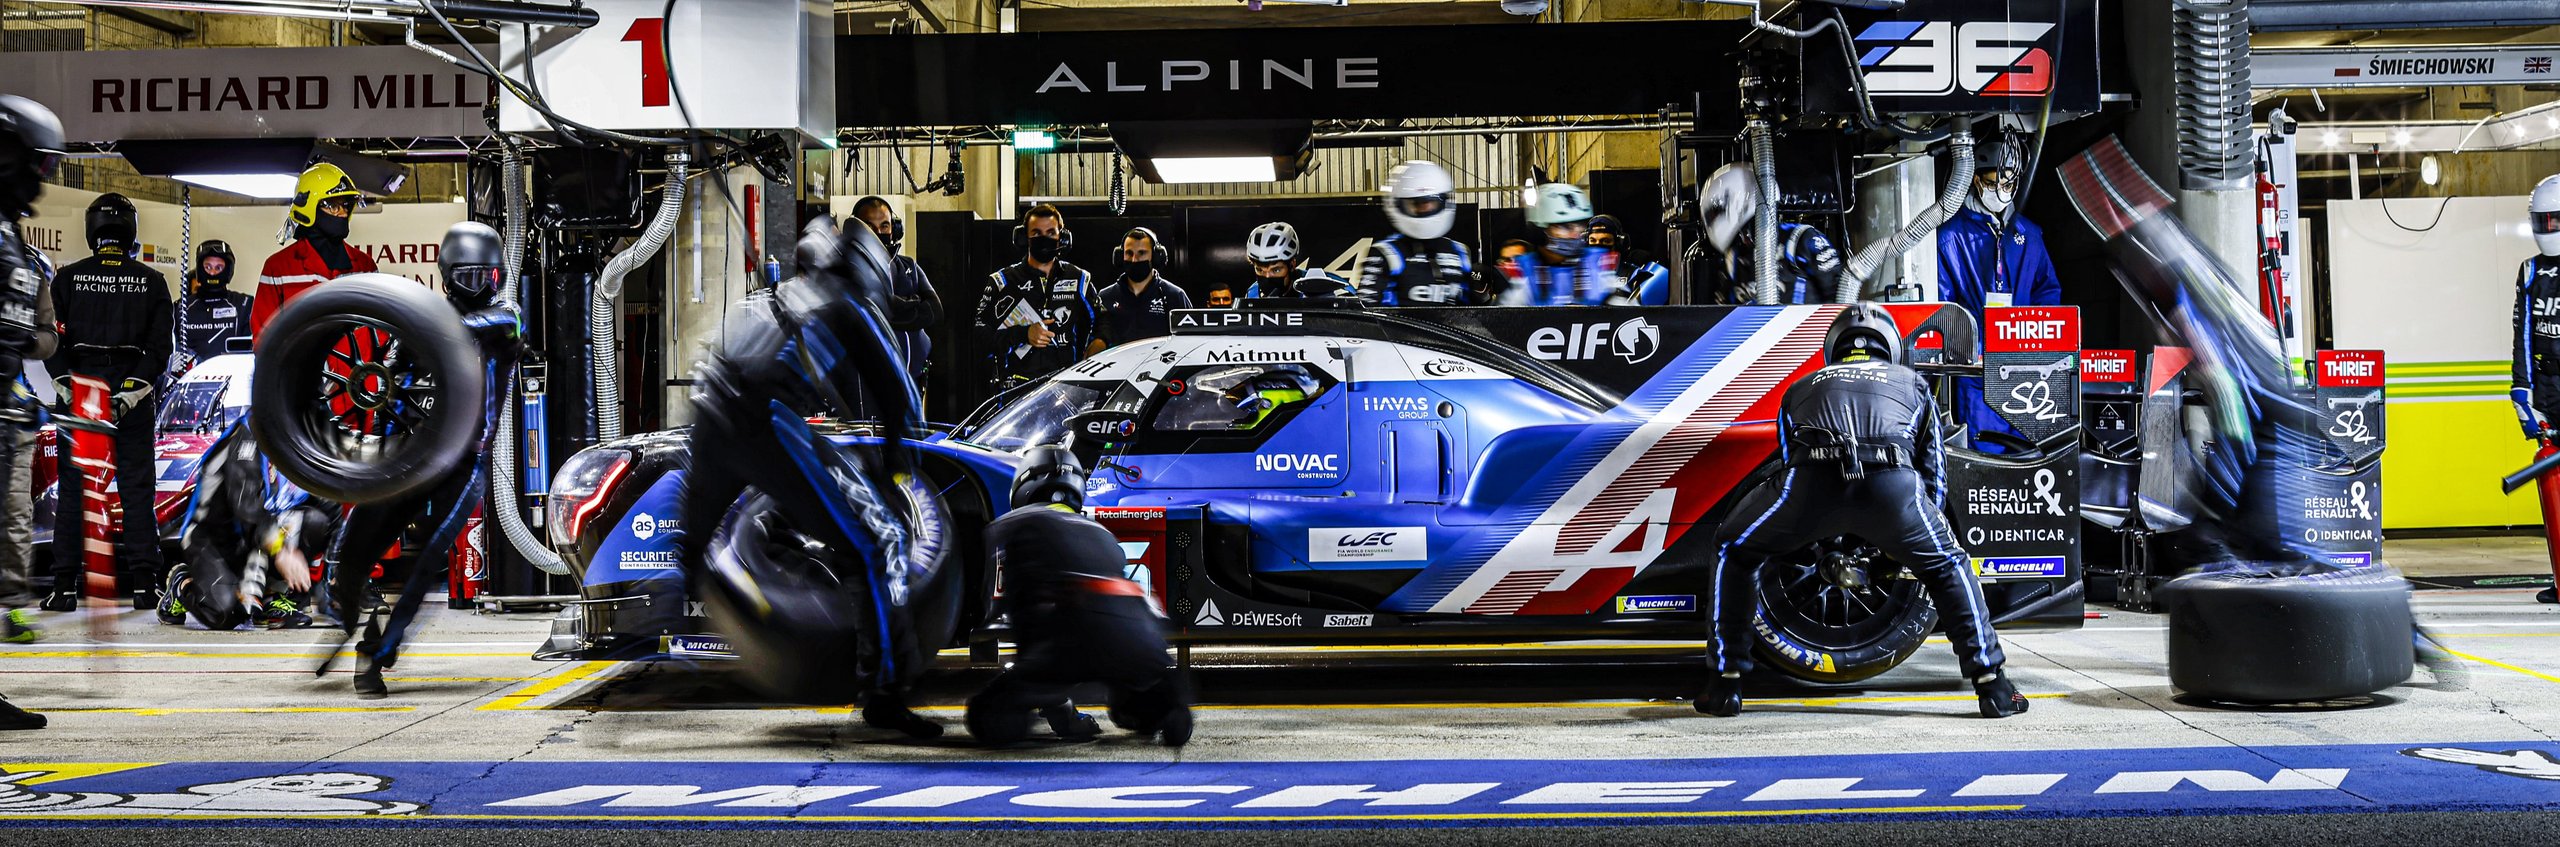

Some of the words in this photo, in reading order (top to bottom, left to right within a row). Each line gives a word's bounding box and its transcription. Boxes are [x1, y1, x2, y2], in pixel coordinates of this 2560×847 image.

[621, 18, 671, 107] 1
[1853, 21, 2057, 96] 36
[2368, 55, 2495, 75] ŚMIECHOWSKI
[1035, 57, 1379, 93] ALPINE
[92, 75, 329, 114] RICHARD
[25, 226, 62, 252] MILLE
[73, 274, 116, 284] RICHARD
[118, 275, 147, 284] MILLE
[75, 284, 117, 293] RACING
[121, 285, 148, 293] TEAM
[1177, 313, 1303, 326] ALPINE
[2010, 310, 2051, 318] MAISON
[1995, 321, 2066, 340] THIRIET
[1526, 322, 1611, 360] elf
[1206, 348, 1308, 363] Matmut
[2081, 359, 2127, 373] THIRIET
[2324, 361, 2376, 377] THIRIET
[1363, 397, 1429, 411] HAVAS
[1398, 411, 1429, 419] GROUP
[1087, 420, 1117, 434] elf
[1255, 454, 1338, 471] NOVAC
[1968, 486, 2029, 502] RÉSEAU
[1968, 502, 2044, 515] RENAULT
[2304, 495, 2347, 508] RÉSEAU
[1097, 510, 1164, 520] TotalEnergies
[2304, 508, 2358, 519] RENAULT
[635, 520, 652, 532] as
[1337, 532, 1397, 547] WEC
[1990, 529, 2065, 542] IDENTICAR
[2320, 529, 2373, 541] IDENTICAR
[1998, 563, 2055, 572] MICHELIN
[1638, 600, 1686, 609] MICHELIN
[1232, 612, 1303, 627] DEWESoft
[1329, 615, 1369, 626] Sabelt
[488, 767, 2351, 808] MICHELIN
